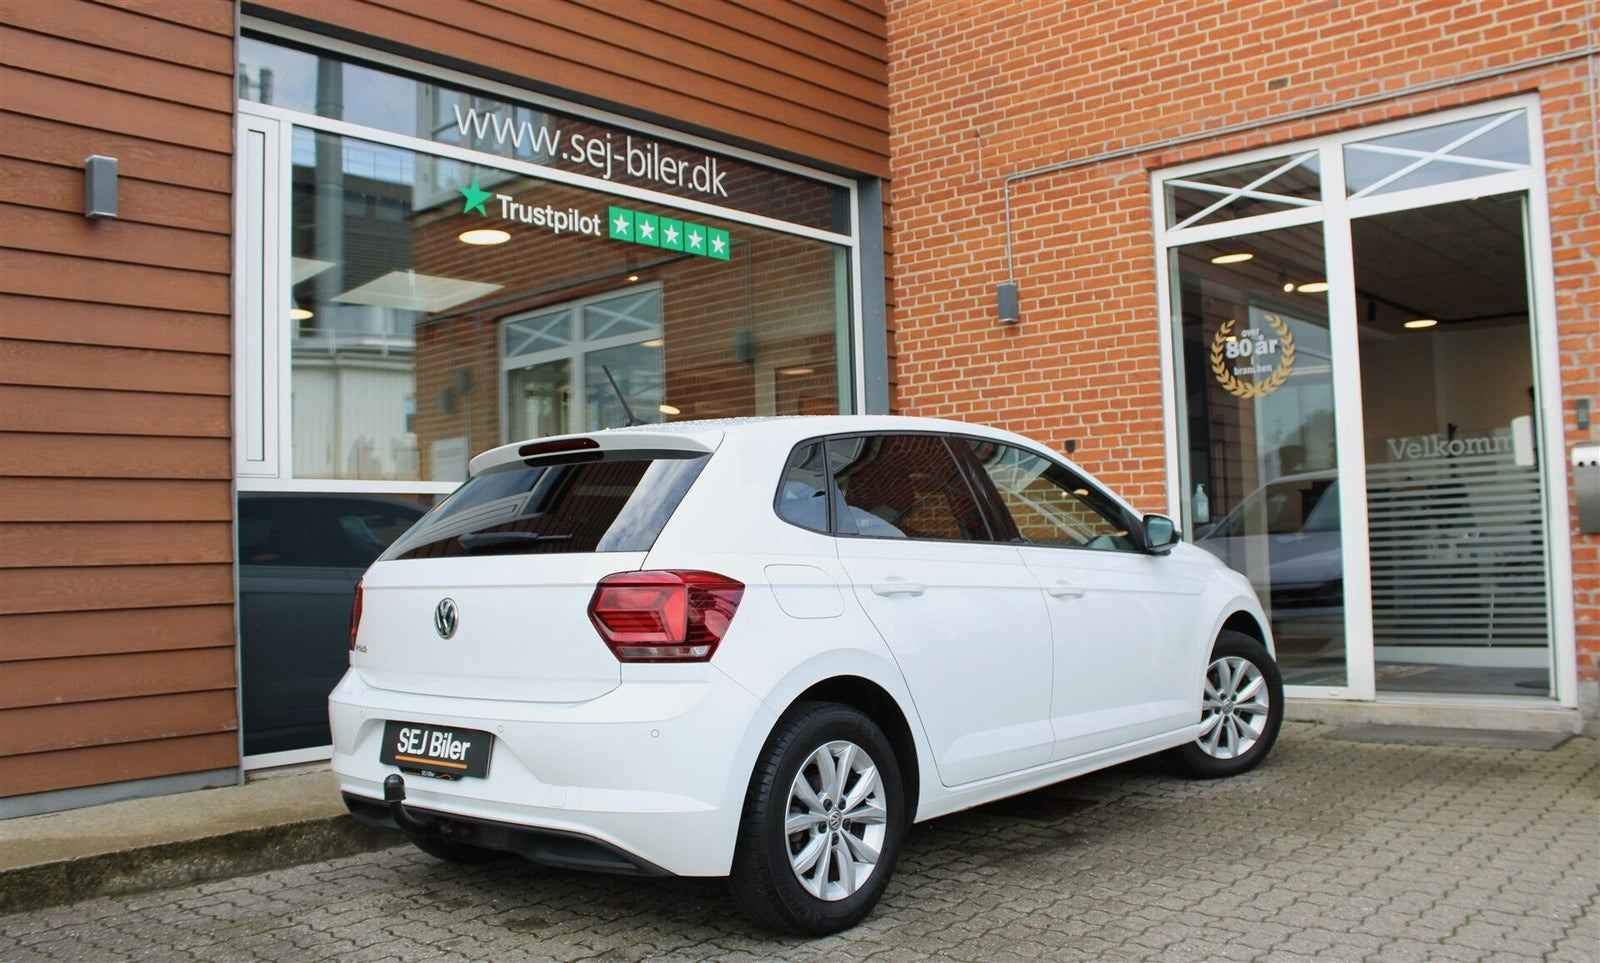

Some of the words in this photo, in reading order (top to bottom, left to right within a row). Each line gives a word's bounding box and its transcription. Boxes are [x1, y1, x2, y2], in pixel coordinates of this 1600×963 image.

[453, 104, 728, 197] www.sej-biler.dk
[496, 194, 601, 236] Trustpilot
[1226, 339, 1252, 358] 80
[1255, 335, 1278, 355] år
[1242, 328, 1260, 337] over
[1234, 364, 1272, 375] branchen
[397, 727, 428, 755] SEJ
[428, 731, 471, 760] Biler
